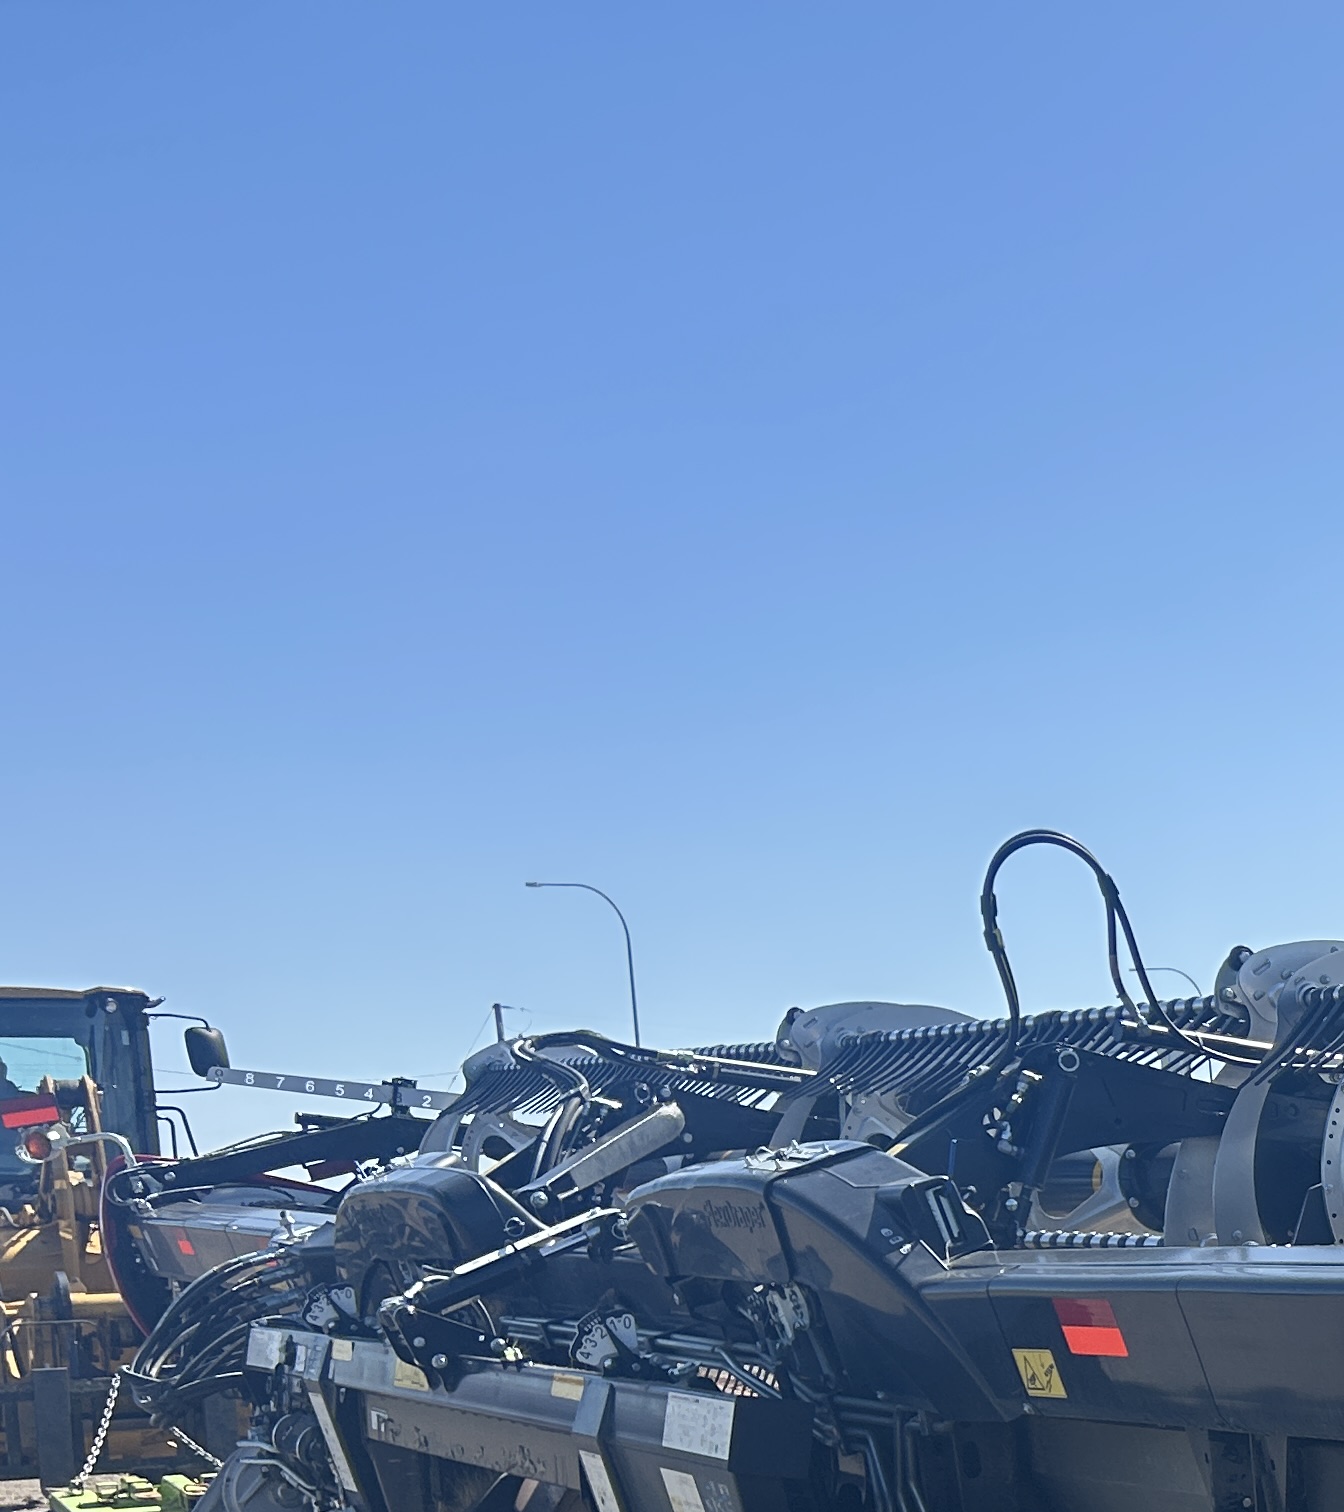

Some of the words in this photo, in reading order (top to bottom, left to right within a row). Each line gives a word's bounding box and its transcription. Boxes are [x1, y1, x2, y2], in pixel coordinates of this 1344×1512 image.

[245, 1073, 254, 1085] 8
[276, 1076, 285, 1088] 7
[305, 1080, 315, 1092] 6
[335, 1084, 345, 1096] 5
[363, 1088, 374, 1100] 4
[421, 1095, 432, 1108] 2
